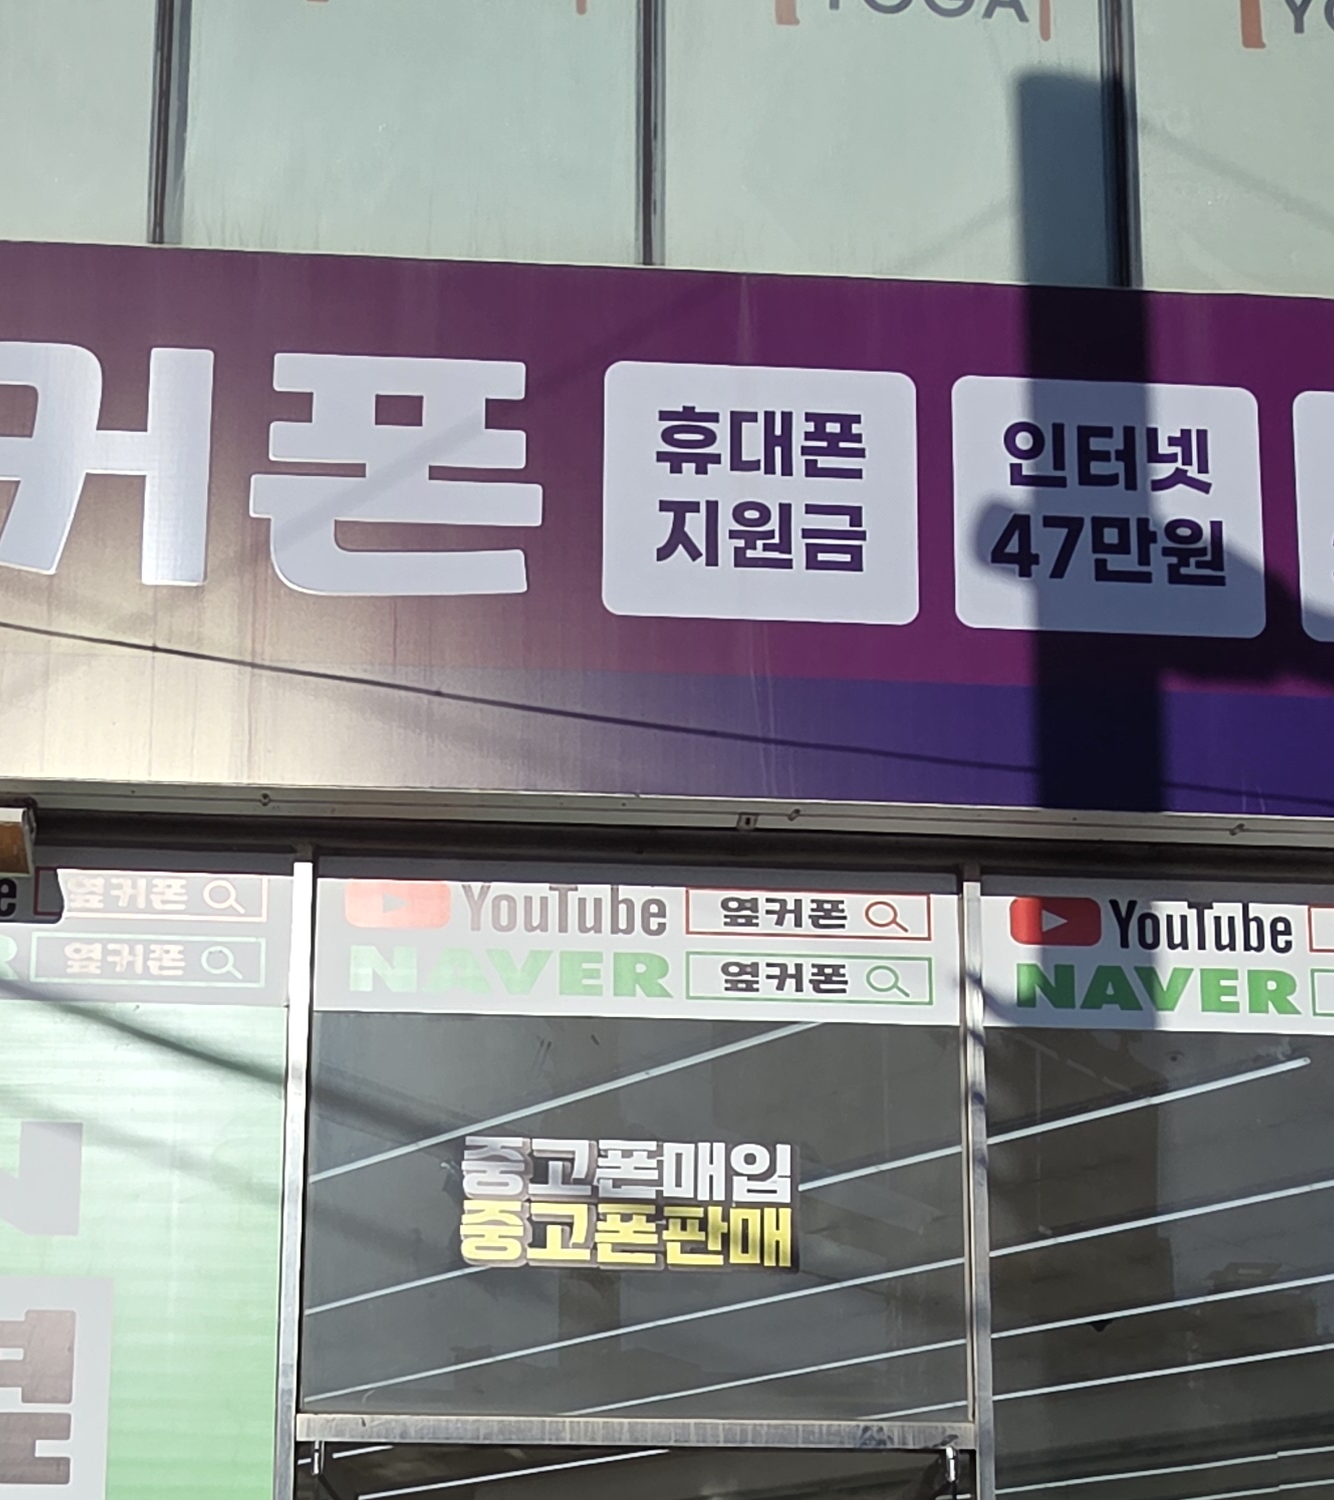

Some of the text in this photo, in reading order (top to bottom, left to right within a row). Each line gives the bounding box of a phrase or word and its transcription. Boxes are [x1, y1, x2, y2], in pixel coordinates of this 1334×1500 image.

[656, 406, 867, 480] 휴대폰
[1002, 422, 1213, 494] 인터넷
[656, 499, 867, 573] 지원금
[990, 512, 1227, 588] 47만원
[67, 875, 189, 911] 옆커폰
[461, 884, 848, 935] YouTube 옆커폰
[1109, 899, 1293, 954] YouTube
[63, 942, 186, 976] 옆커폰
[349, 944, 849, 998] NAVER 옆커폰
[1016, 963, 1301, 1015] NAVER
[461, 1136, 792, 1203] 중고폰매입
[460, 1199, 792, 1267] 중고폰판매
